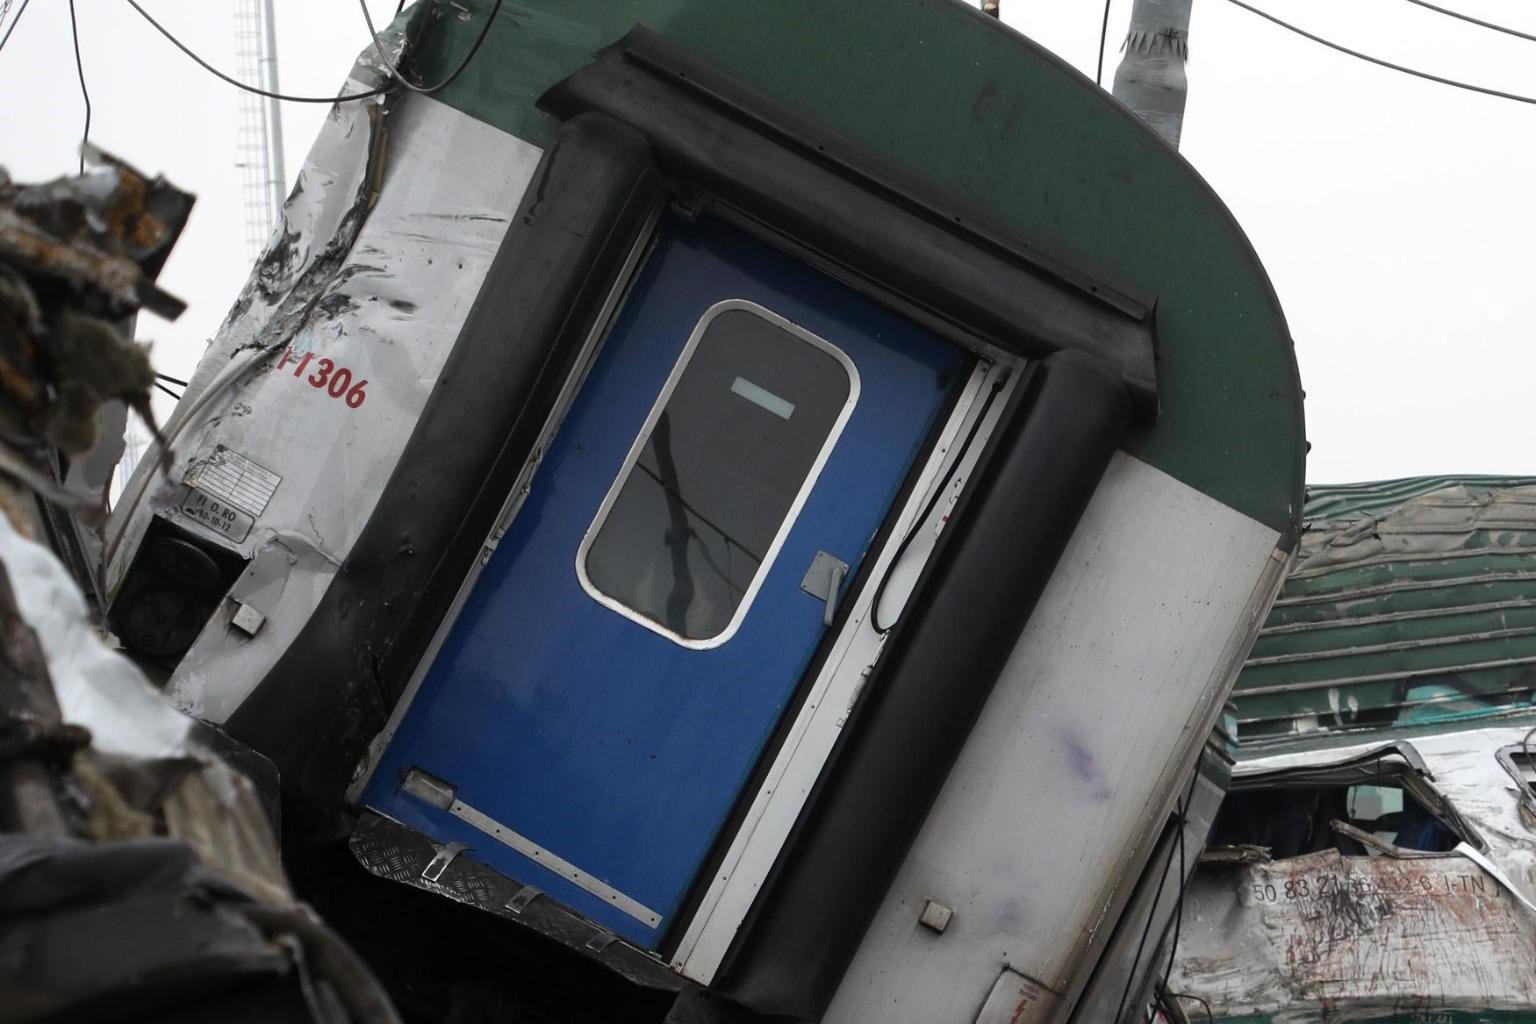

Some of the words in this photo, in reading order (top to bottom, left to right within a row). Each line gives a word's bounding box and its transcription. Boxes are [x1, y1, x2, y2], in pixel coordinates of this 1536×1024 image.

[1253, 884, 1277, 902] 50
[1284, 878, 1310, 899] 83
[1444, 874, 1486, 893] I-TN
